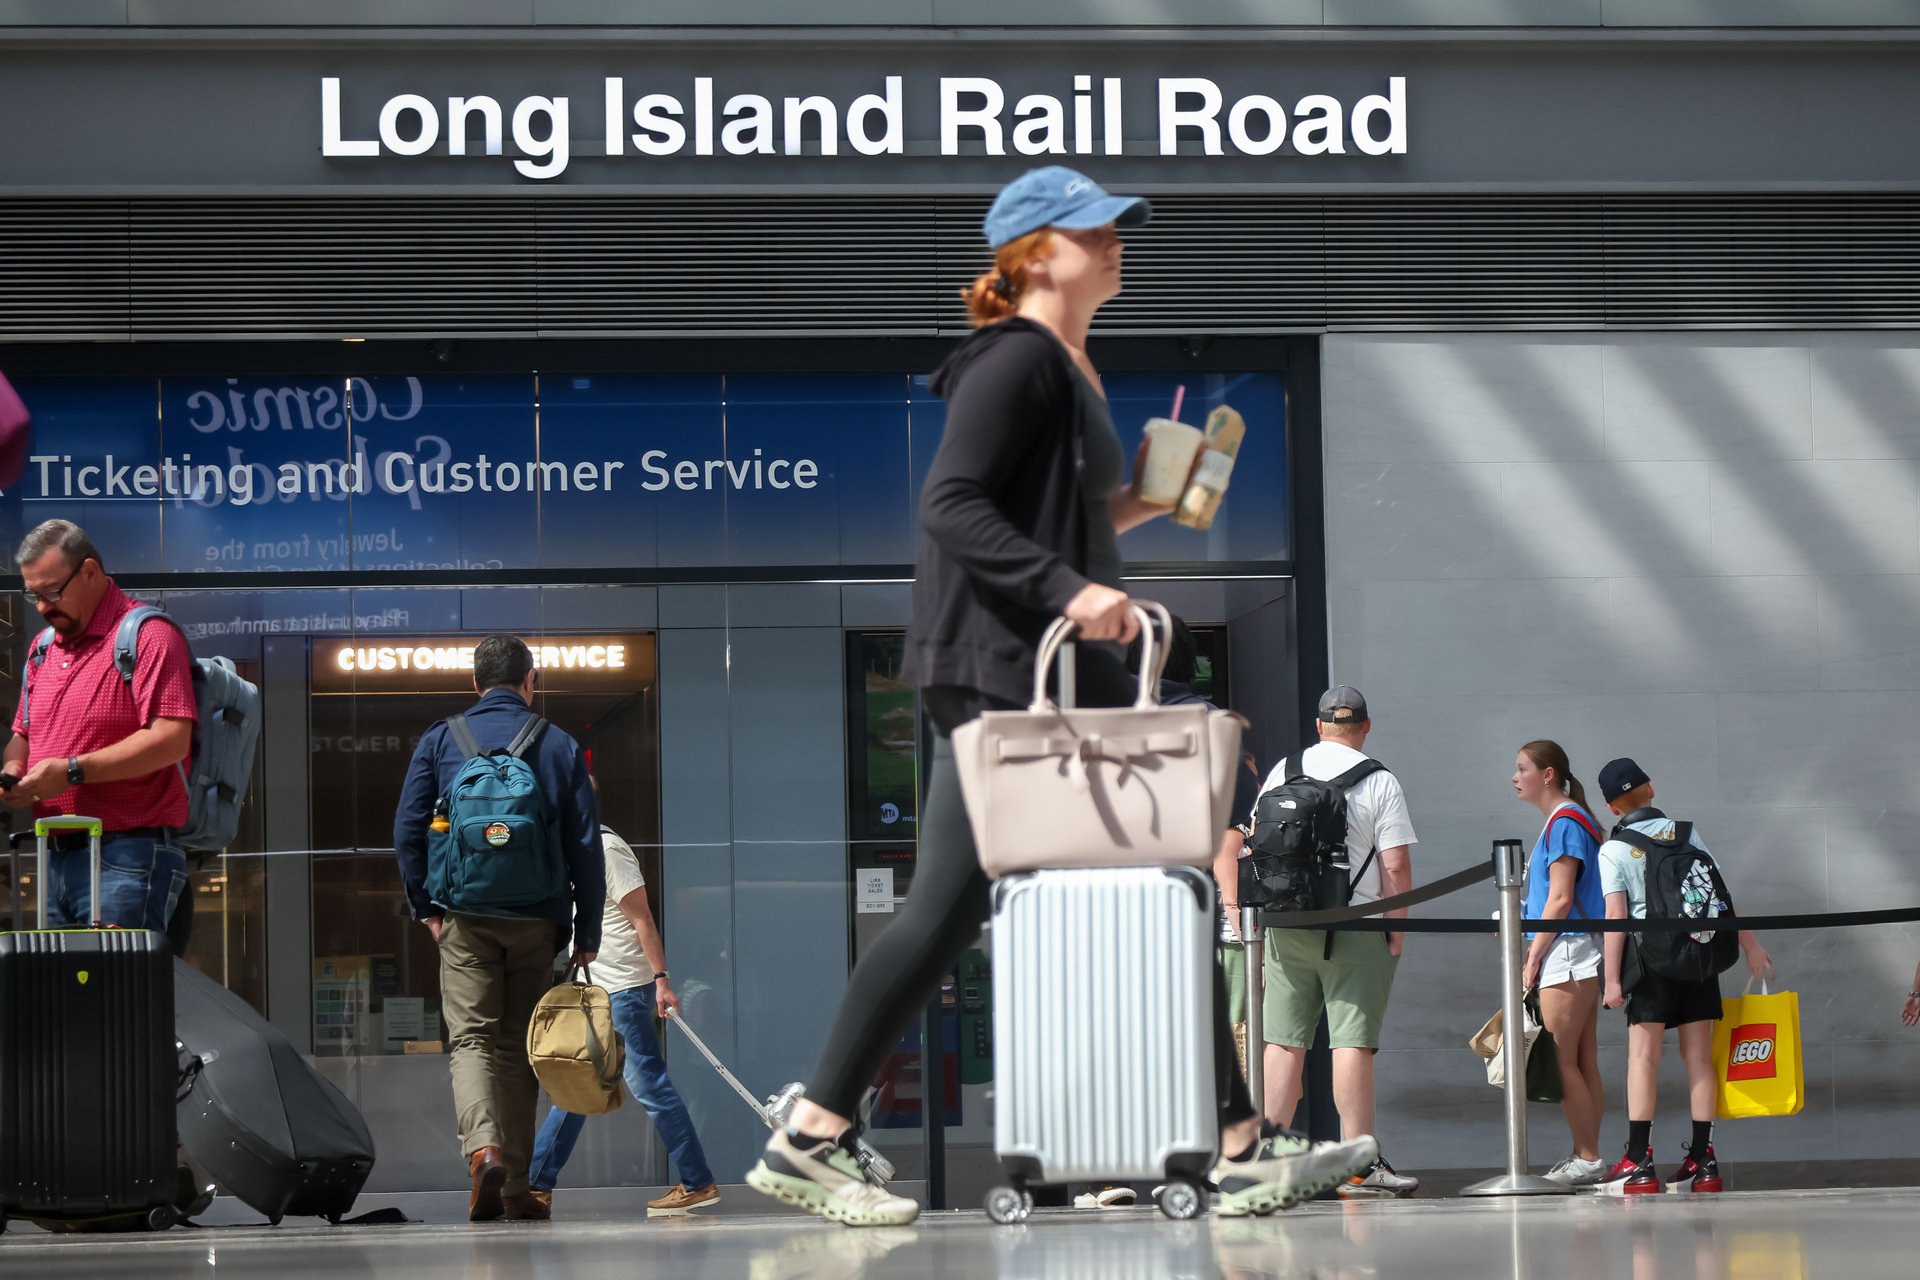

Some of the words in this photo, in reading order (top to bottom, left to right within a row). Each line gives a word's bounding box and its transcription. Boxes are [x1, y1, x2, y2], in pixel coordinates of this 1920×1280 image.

[322, 77, 570, 180] Long
[606, 76, 904, 156] Island
[941, 75, 1123, 156] Rail
[1158, 76, 1407, 156] Road
[30, 454, 253, 506] Ticketing
[278, 453, 363, 493] and
[384, 451, 625, 493] Customer
[641, 450, 818, 491] Service
[337, 647, 476, 671] CUSTOME
[530, 645, 626, 668] ERVICE
[1732, 1039, 1773, 1065] LEGO
